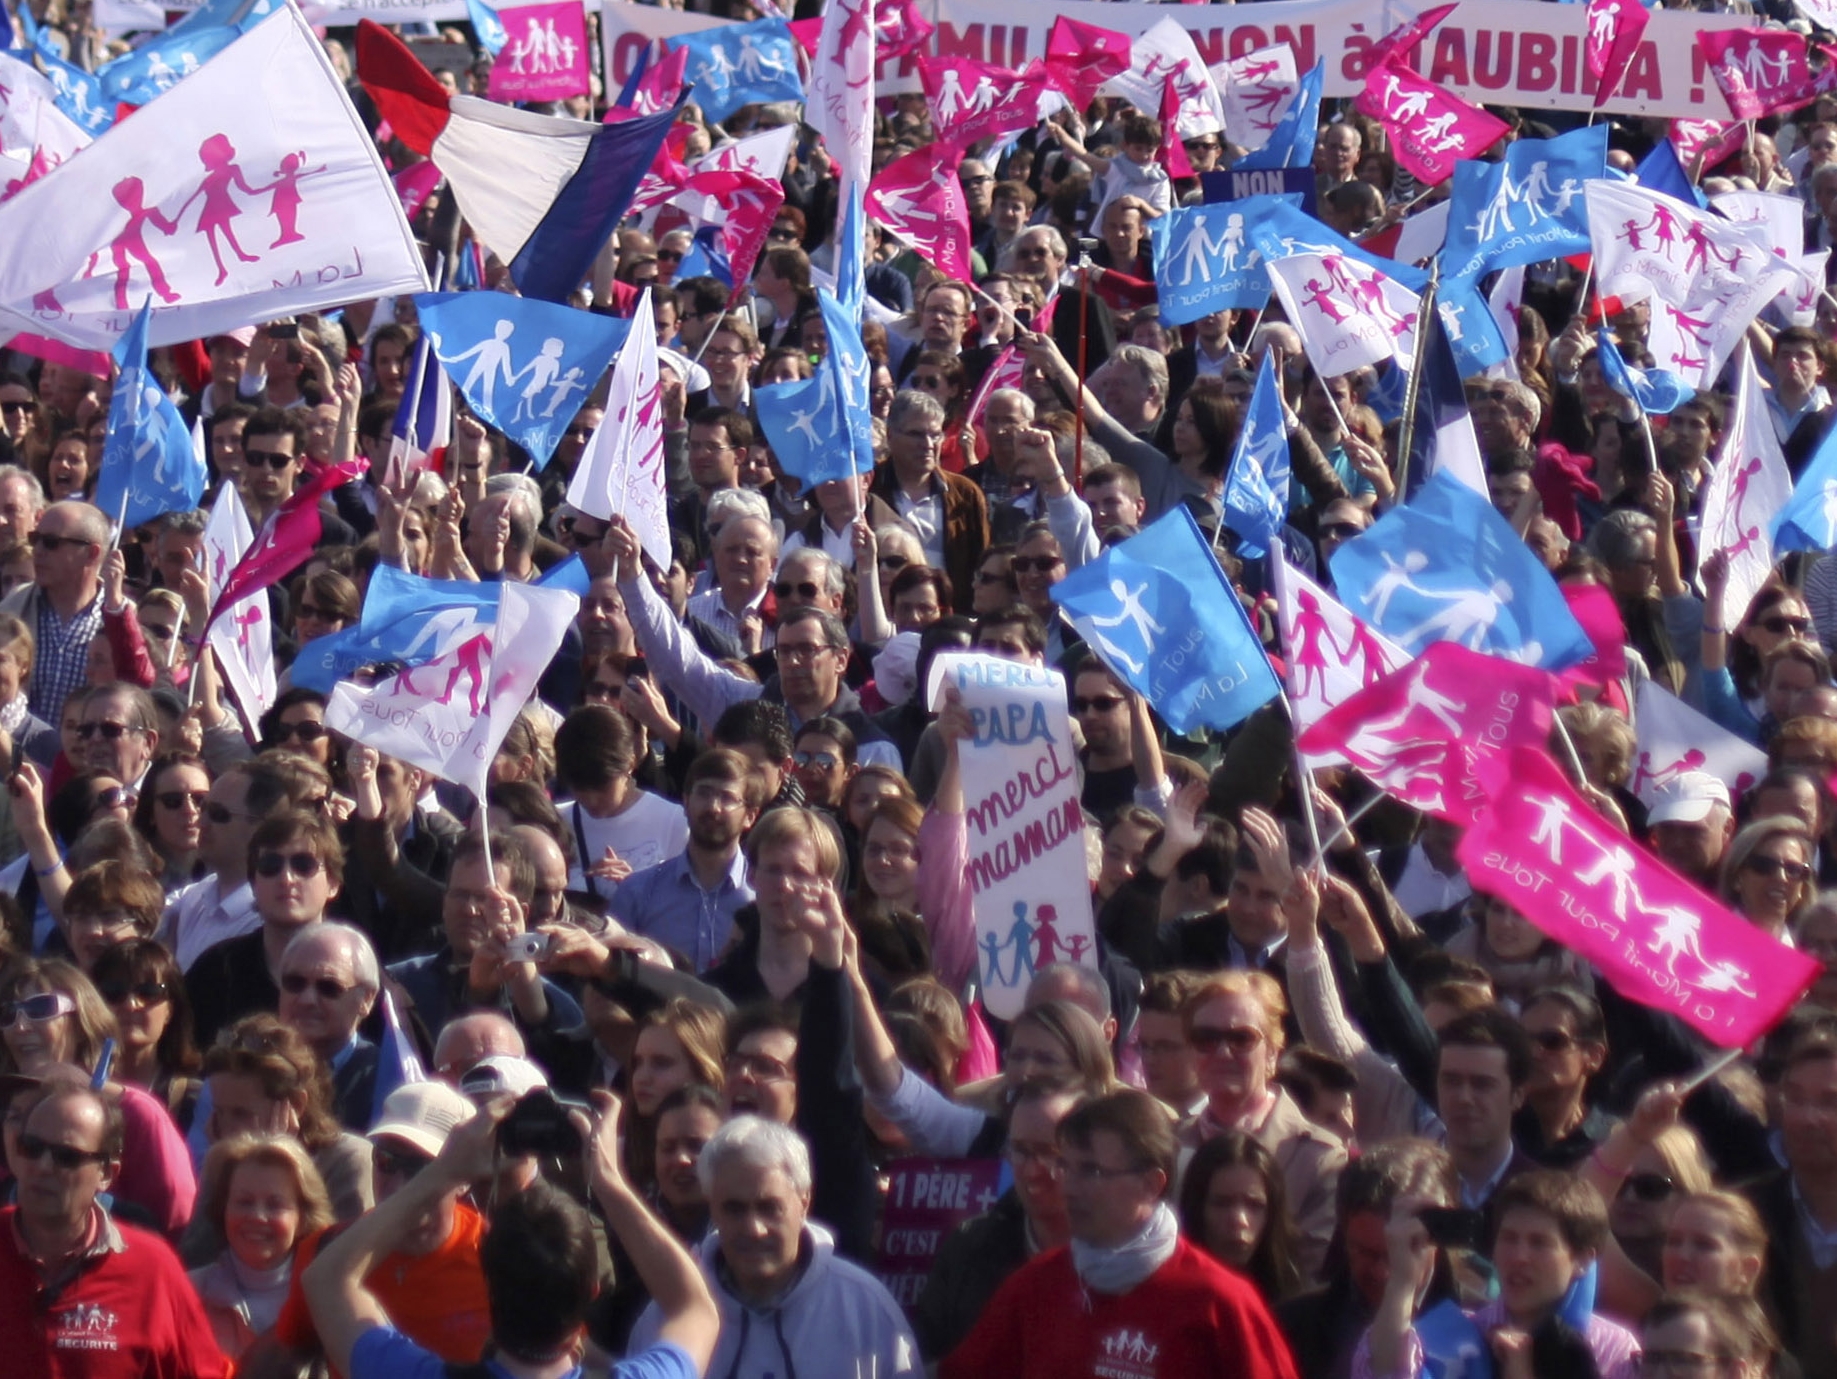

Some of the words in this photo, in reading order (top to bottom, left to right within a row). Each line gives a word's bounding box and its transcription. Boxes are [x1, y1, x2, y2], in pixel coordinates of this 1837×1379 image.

[1231, 170, 1285, 196] NON
[956, 661, 1059, 689] MERCI
[969, 700, 1059, 749] PAPA
[963, 795, 1087, 895] maman
[912, 1165, 973, 1210] PÈRE
[56, 1338, 118, 1351] SECURITE
